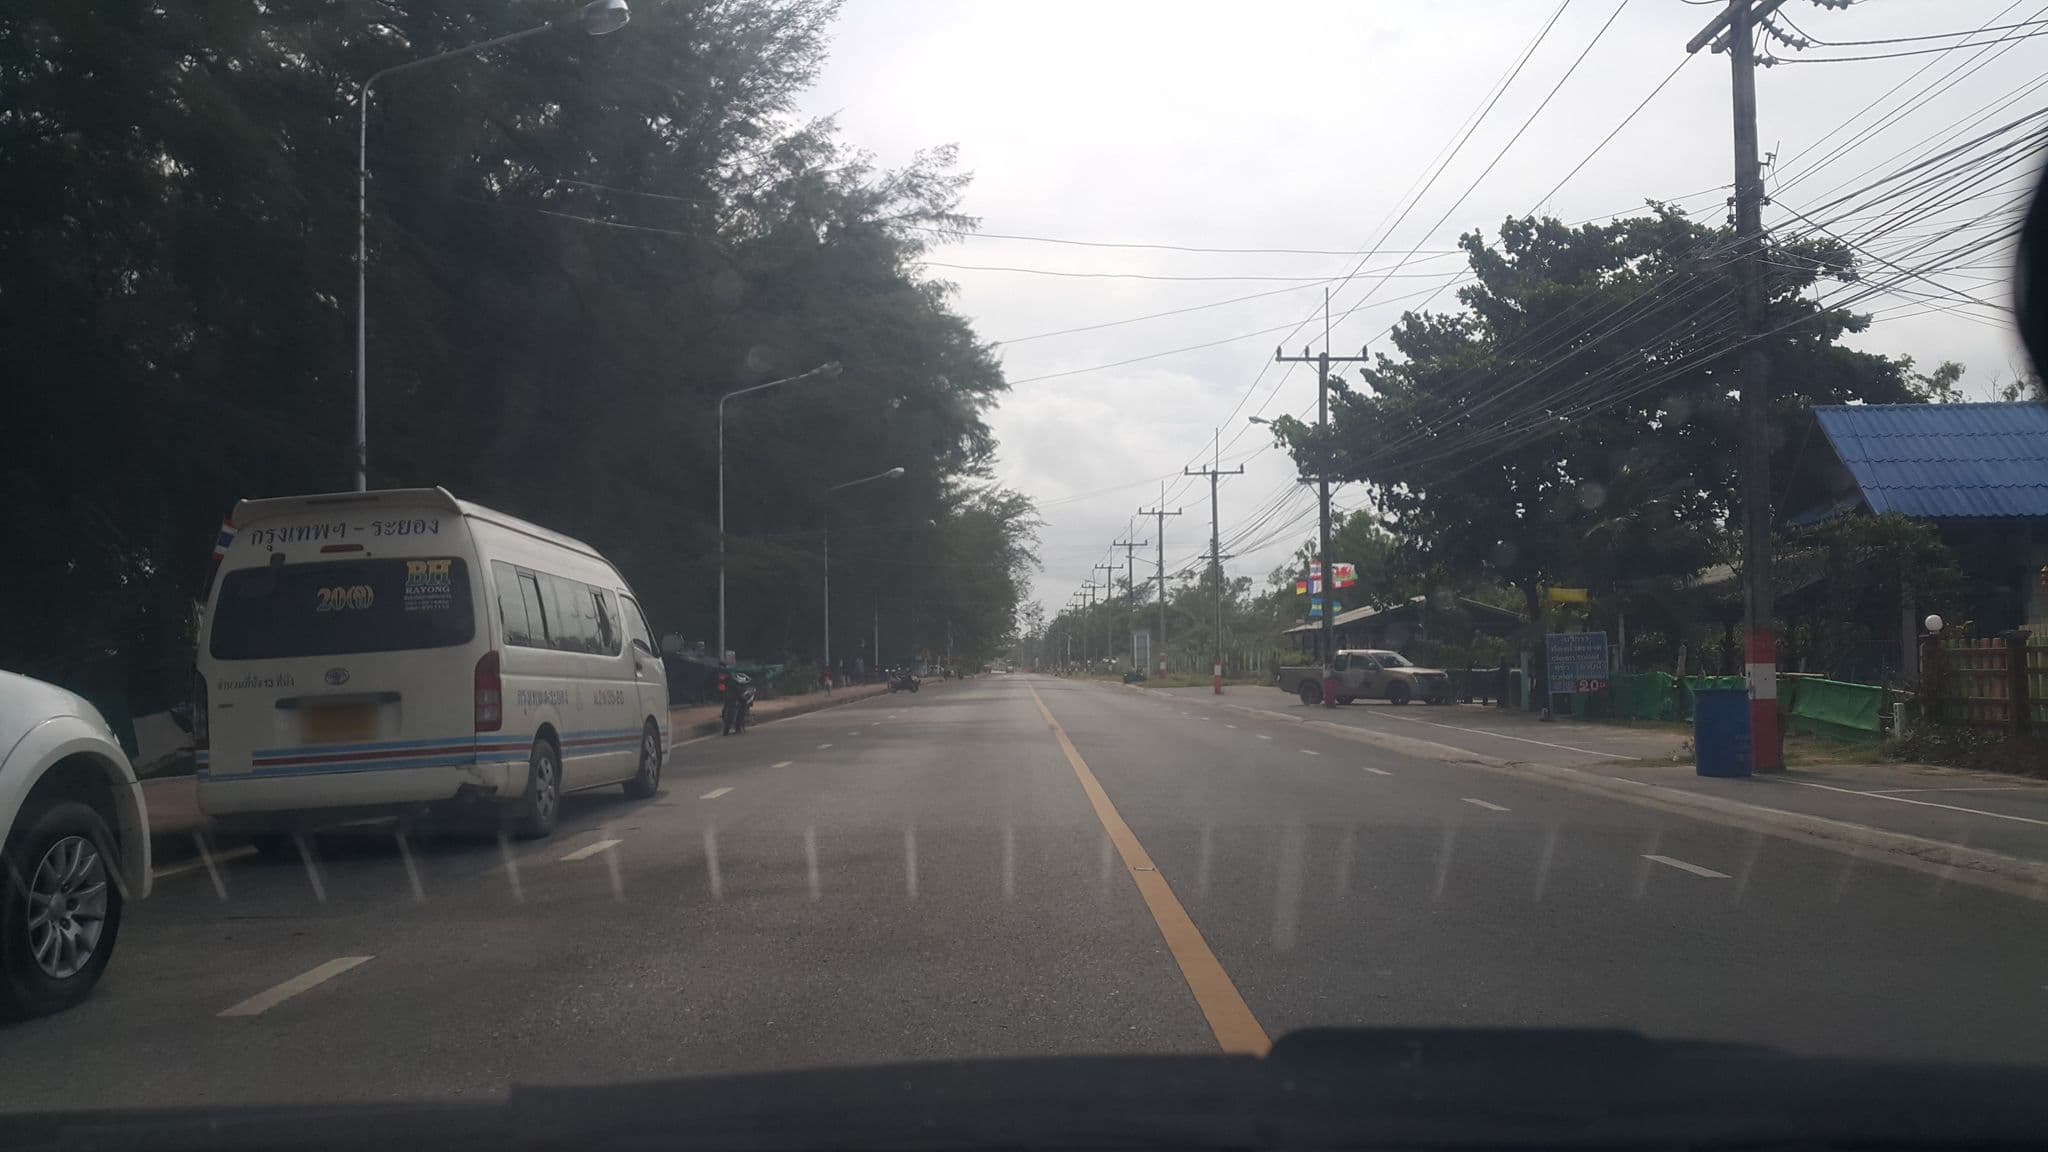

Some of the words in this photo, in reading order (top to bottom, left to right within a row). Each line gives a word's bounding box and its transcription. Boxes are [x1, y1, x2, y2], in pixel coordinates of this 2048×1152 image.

[250, 521, 347, 552] กรุงเทพฯ
[371, 518, 440, 538] ระยอง
[404, 586, 450, 595] RAYONG
